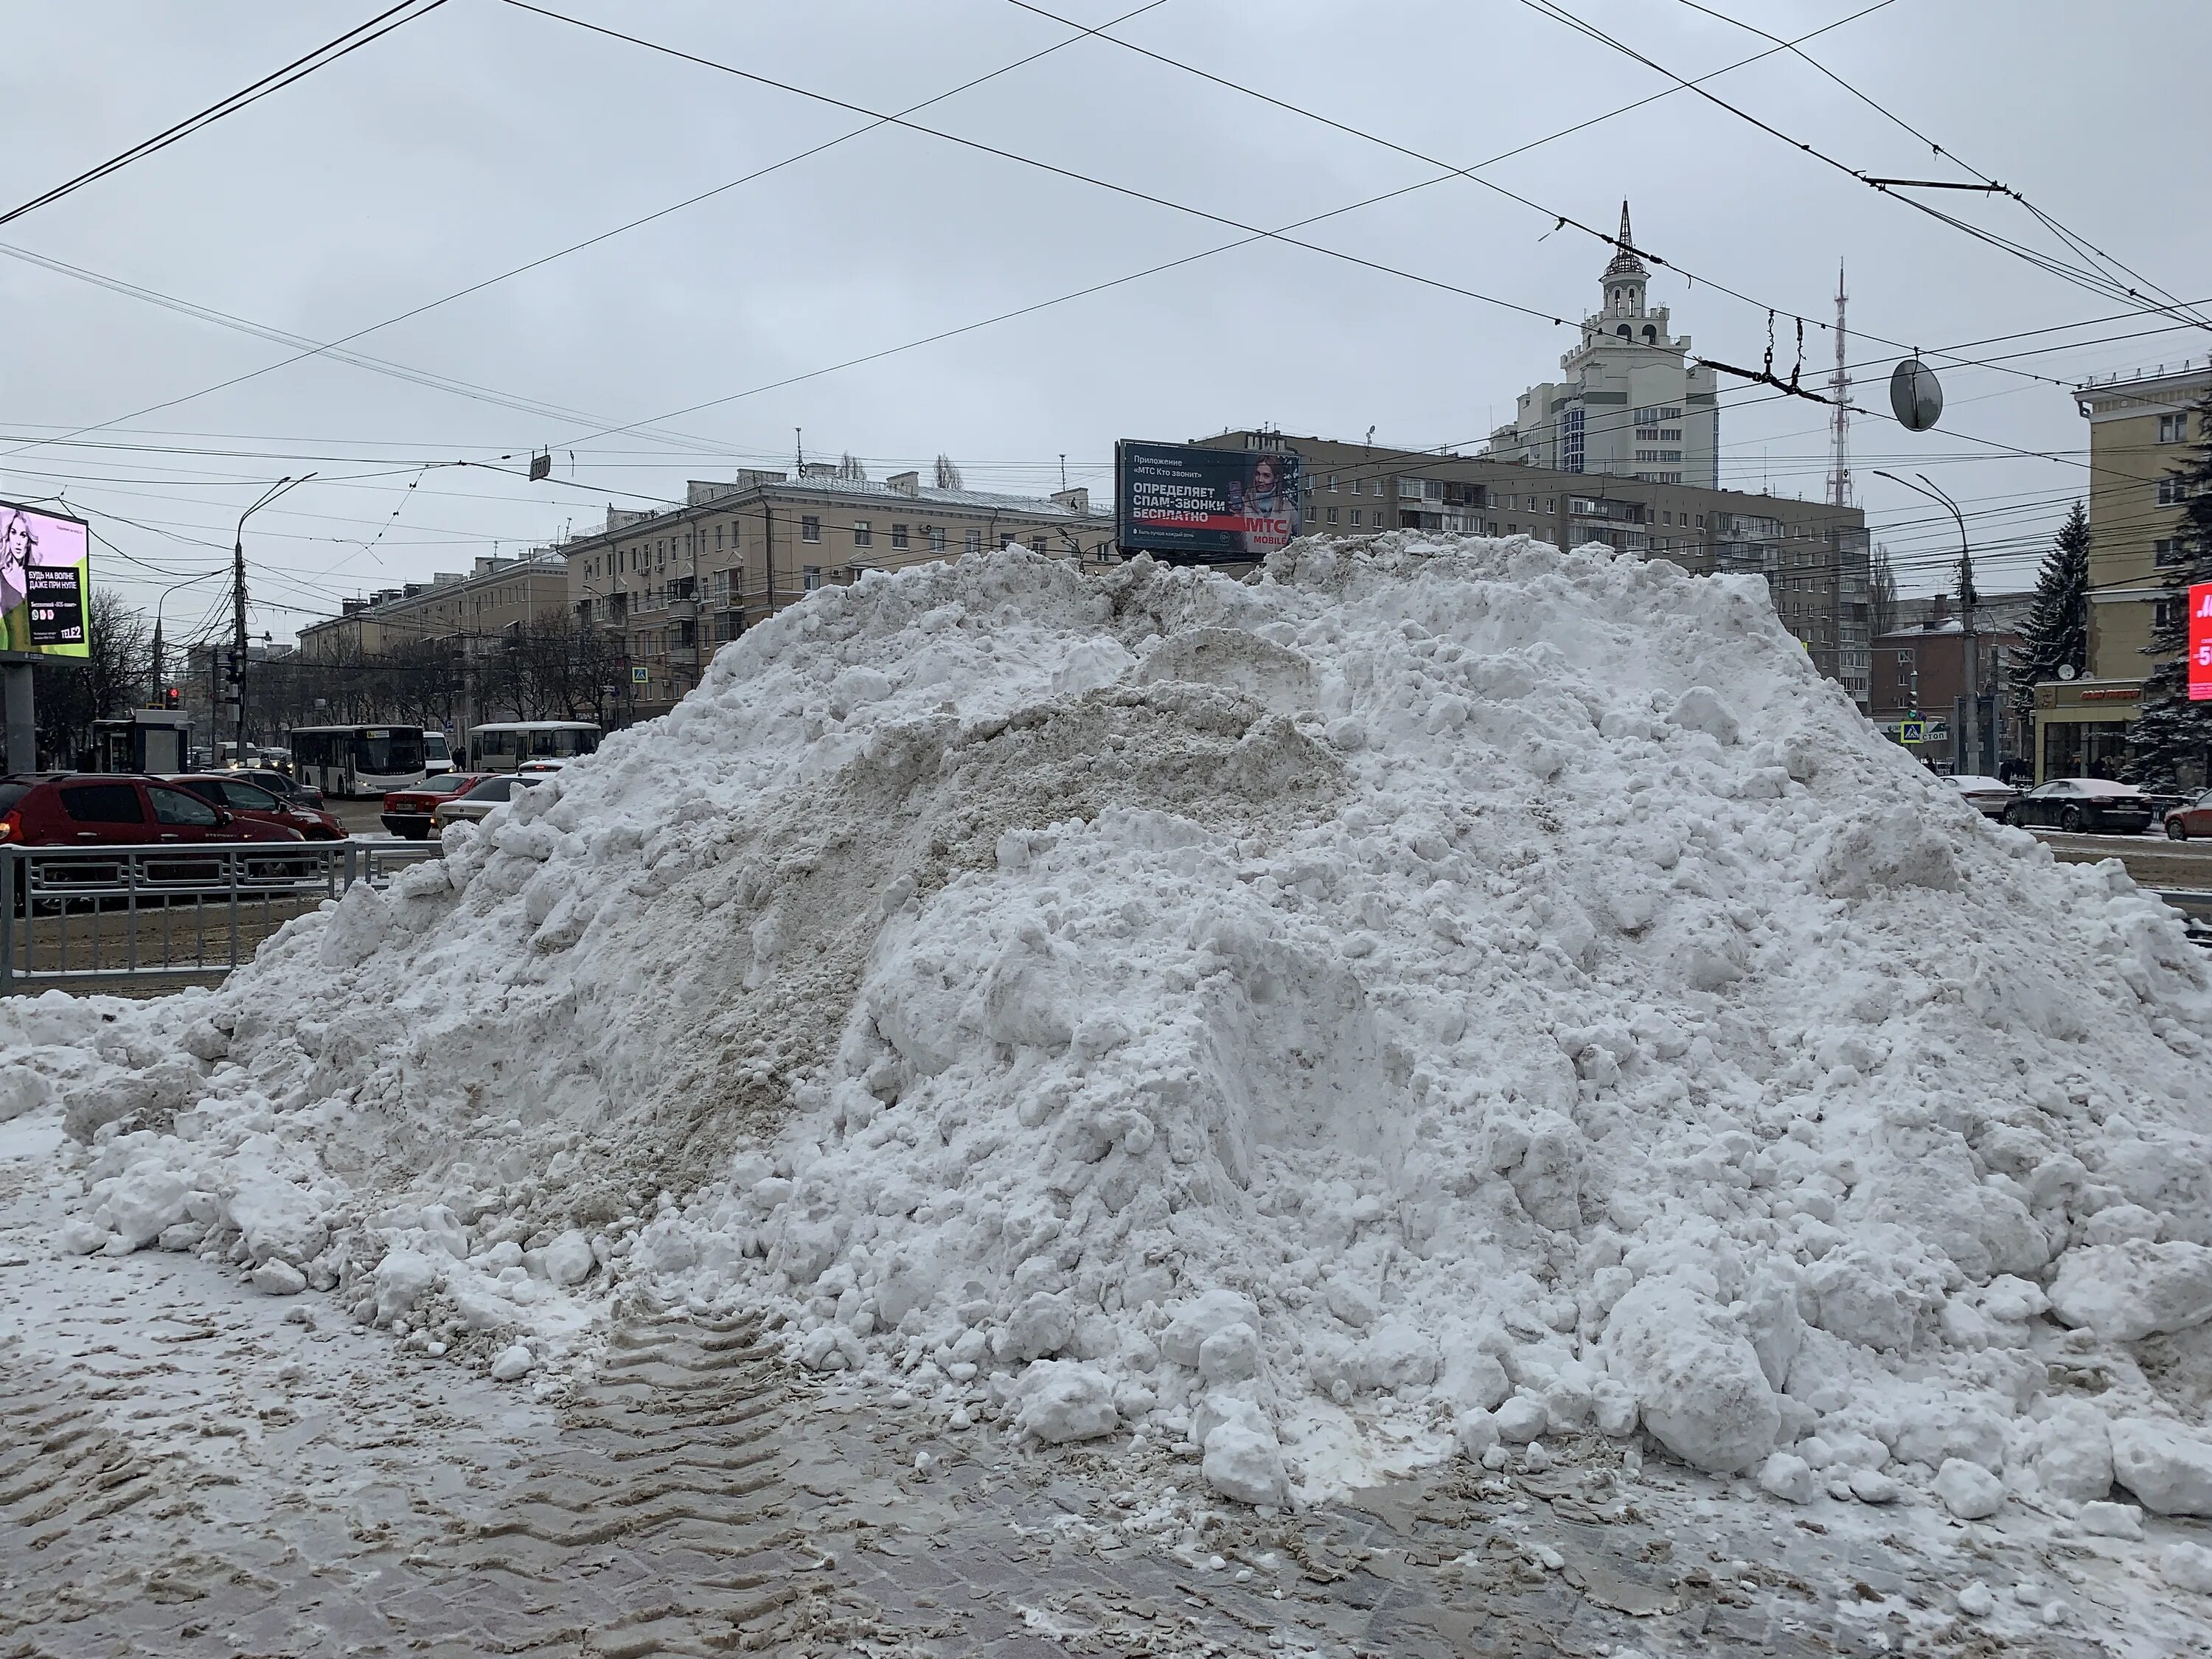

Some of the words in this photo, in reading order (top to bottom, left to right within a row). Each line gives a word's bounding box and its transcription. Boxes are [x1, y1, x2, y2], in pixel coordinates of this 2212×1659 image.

[1133, 455, 1183, 466] Приложение
[1133, 466, 1155, 475] «МТС
[1156, 468, 1171, 476] Кто
[1133, 482, 1215, 498] ОПРЕДЕЛЯЕТ
[1133, 495, 1225, 511] СПАМ-ЗВОНКИ
[1133, 507, 1208, 522] БЕСПЛАТНО
[1246, 517, 1287, 534] МТС
[1253, 535, 1287, 544] MOBILE
[29, 571, 44, 580] БУДЬ
[54, 572, 74, 580] ВОЛНЕ
[29, 581, 48, 590] ДАЖЕ
[49, 581, 61, 589] ПРИ
[61, 626, 81, 639] TELE2
